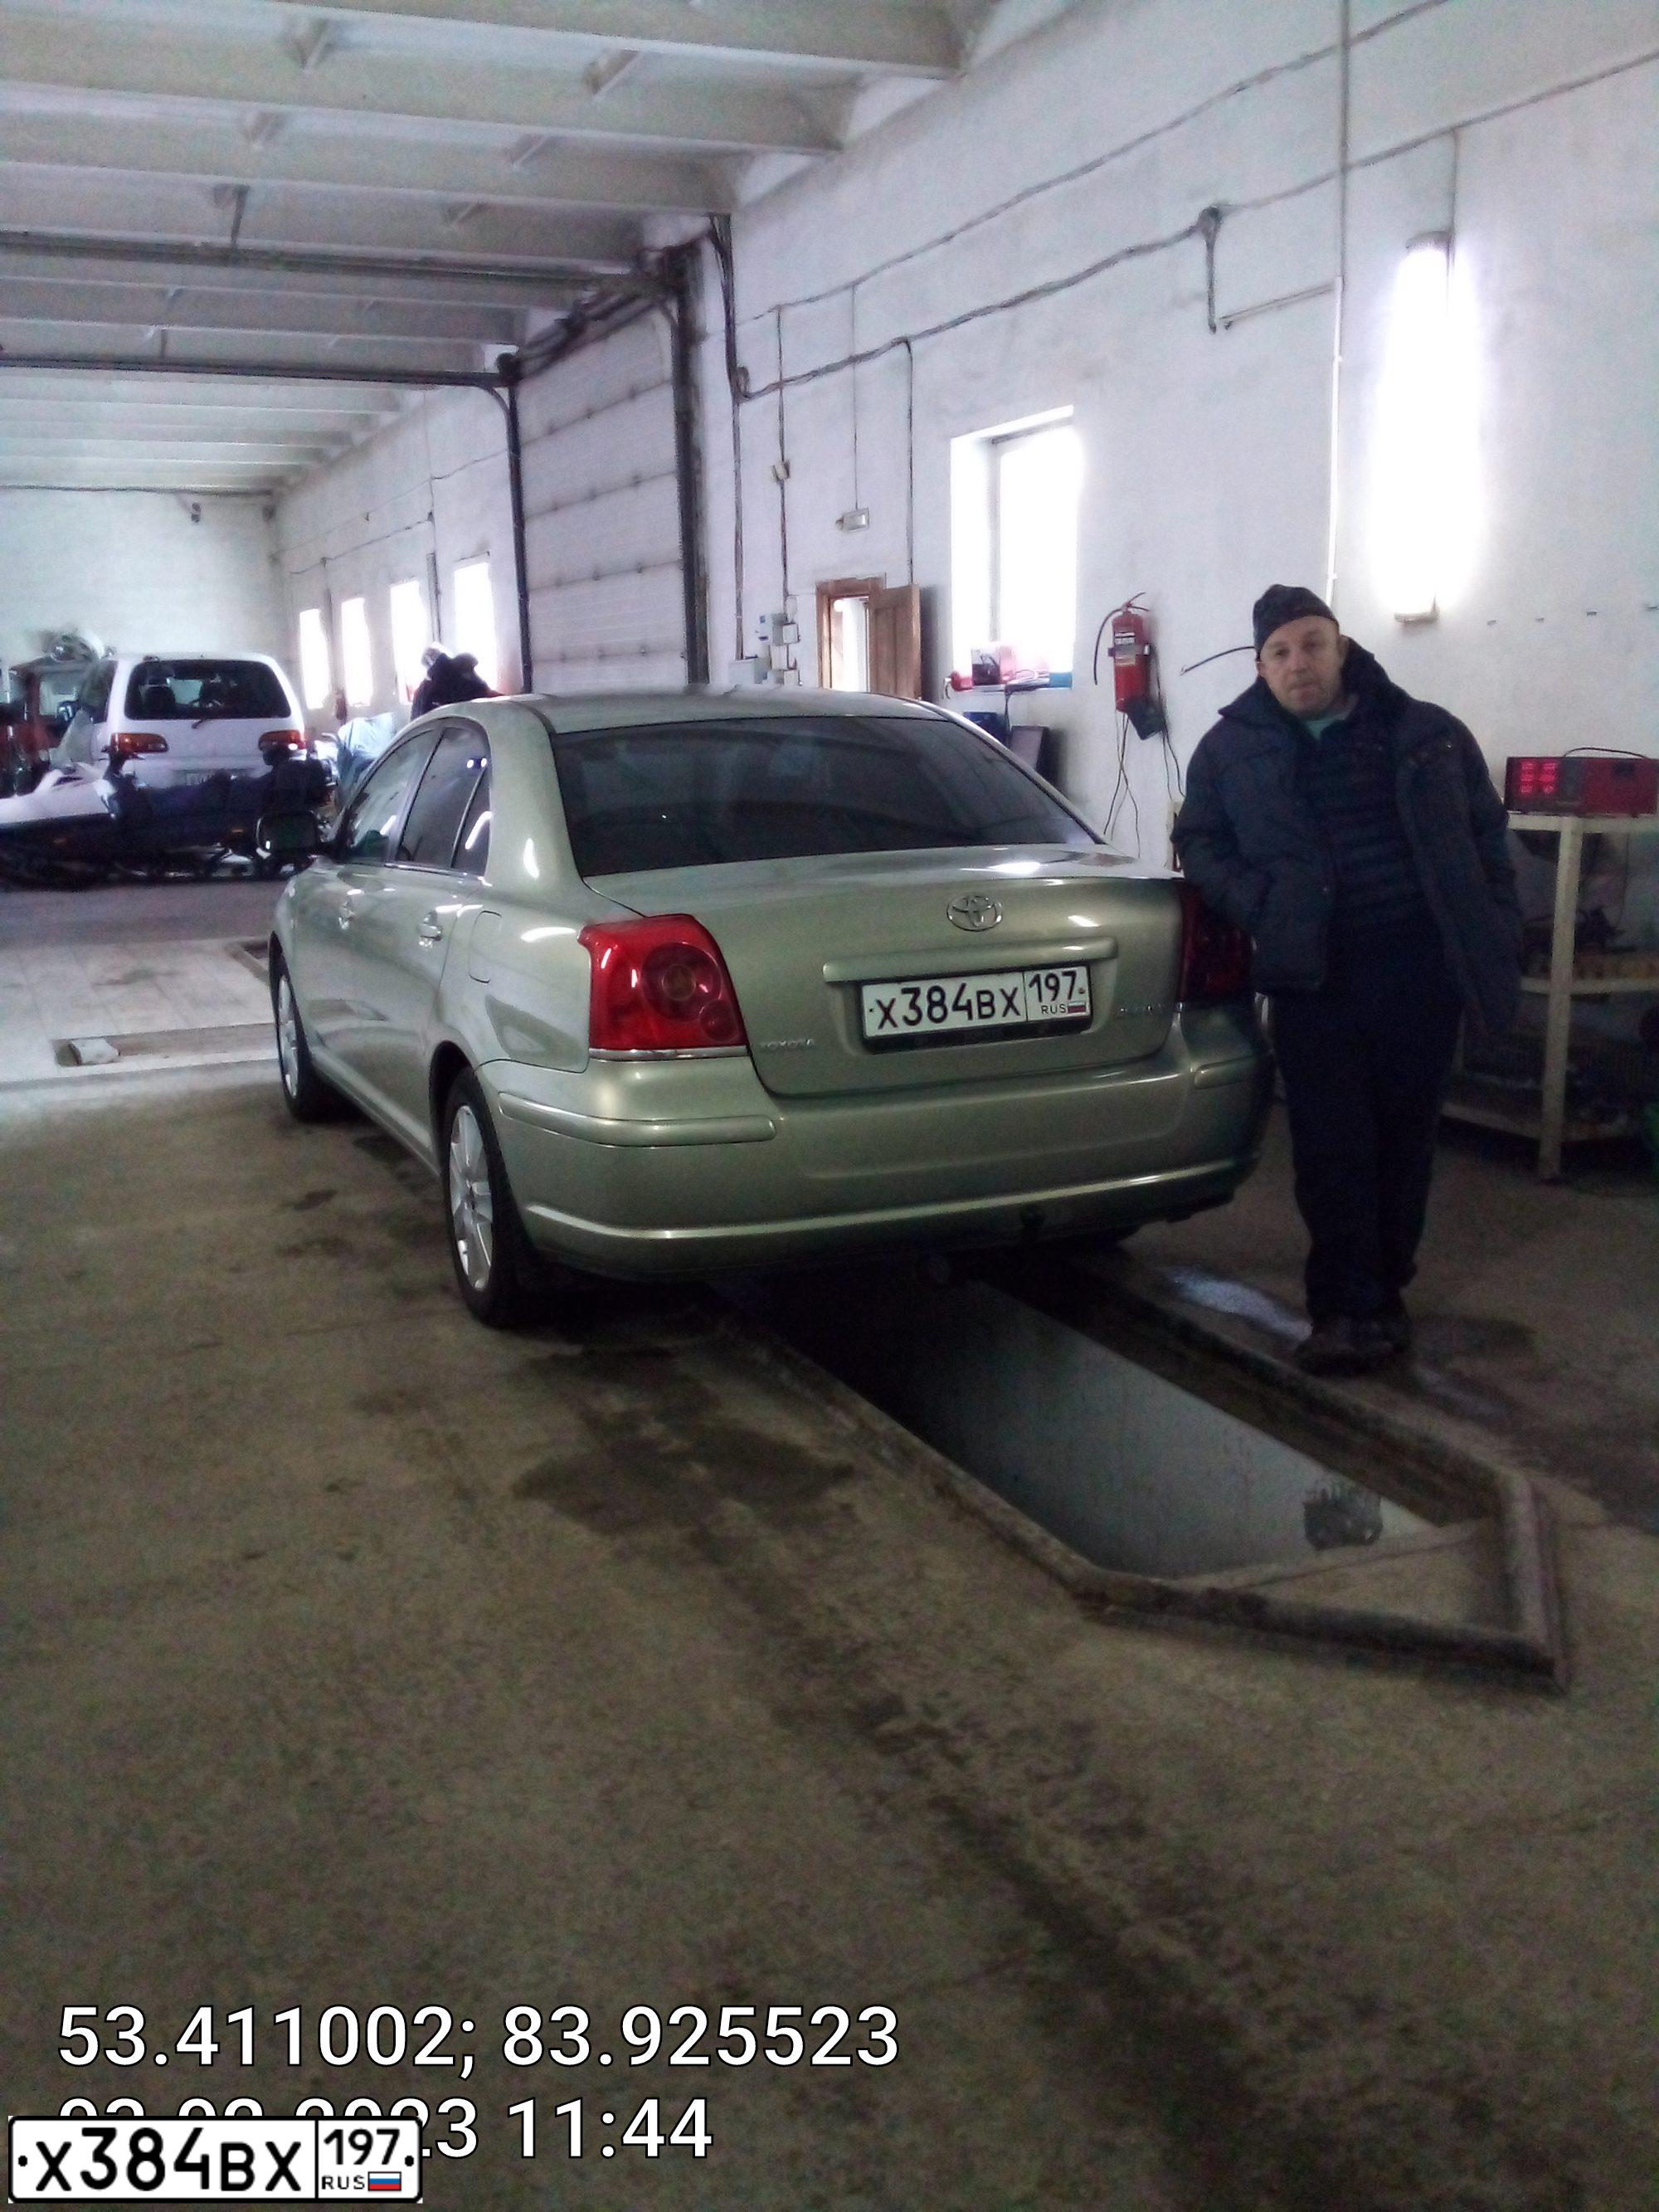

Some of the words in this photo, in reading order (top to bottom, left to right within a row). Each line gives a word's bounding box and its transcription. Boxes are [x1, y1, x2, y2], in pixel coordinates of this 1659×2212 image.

[875, 982, 1021, 1030] Х384ВХ
[1029, 971, 1078, 1003] 197
[1041, 1003, 1067, 1014] RUS
